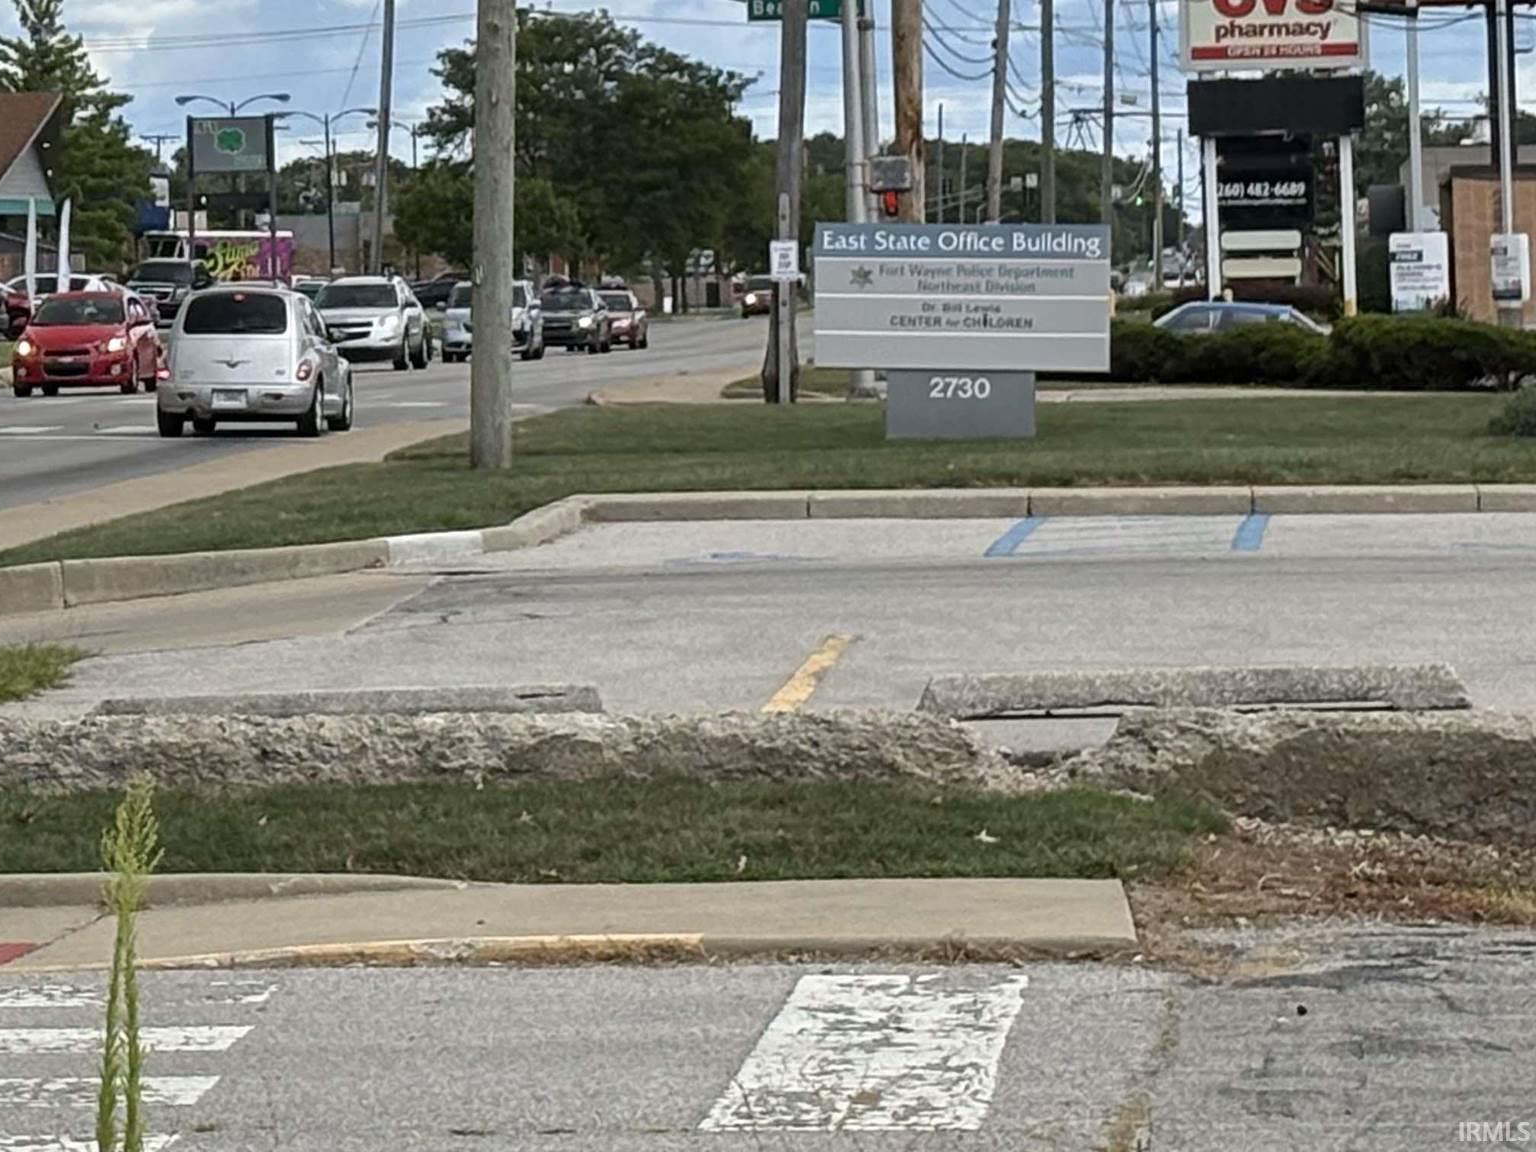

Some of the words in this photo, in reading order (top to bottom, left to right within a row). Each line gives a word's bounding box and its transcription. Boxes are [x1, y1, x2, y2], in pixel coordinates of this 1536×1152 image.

[753, 0, 820, 16] Bean
[1215, 20, 1331, 43] pharmacy
[822, 230, 865, 250] East
[874, 230, 930, 250] State
[938, 231, 1005, 252] Office
[1012, 233, 1101, 257] Building
[879, 264, 904, 276] Fort
[908, 265, 952, 280] Wayne
[957, 265, 994, 277] Police
[998, 265, 1075, 281] Department
[917, 280, 981, 293] Northeast
[985, 281, 1036, 293] Division
[966, 303, 1002, 314] Lewis
[889, 315, 942, 328] CENTER
[929, 377, 991, 399] 2730
